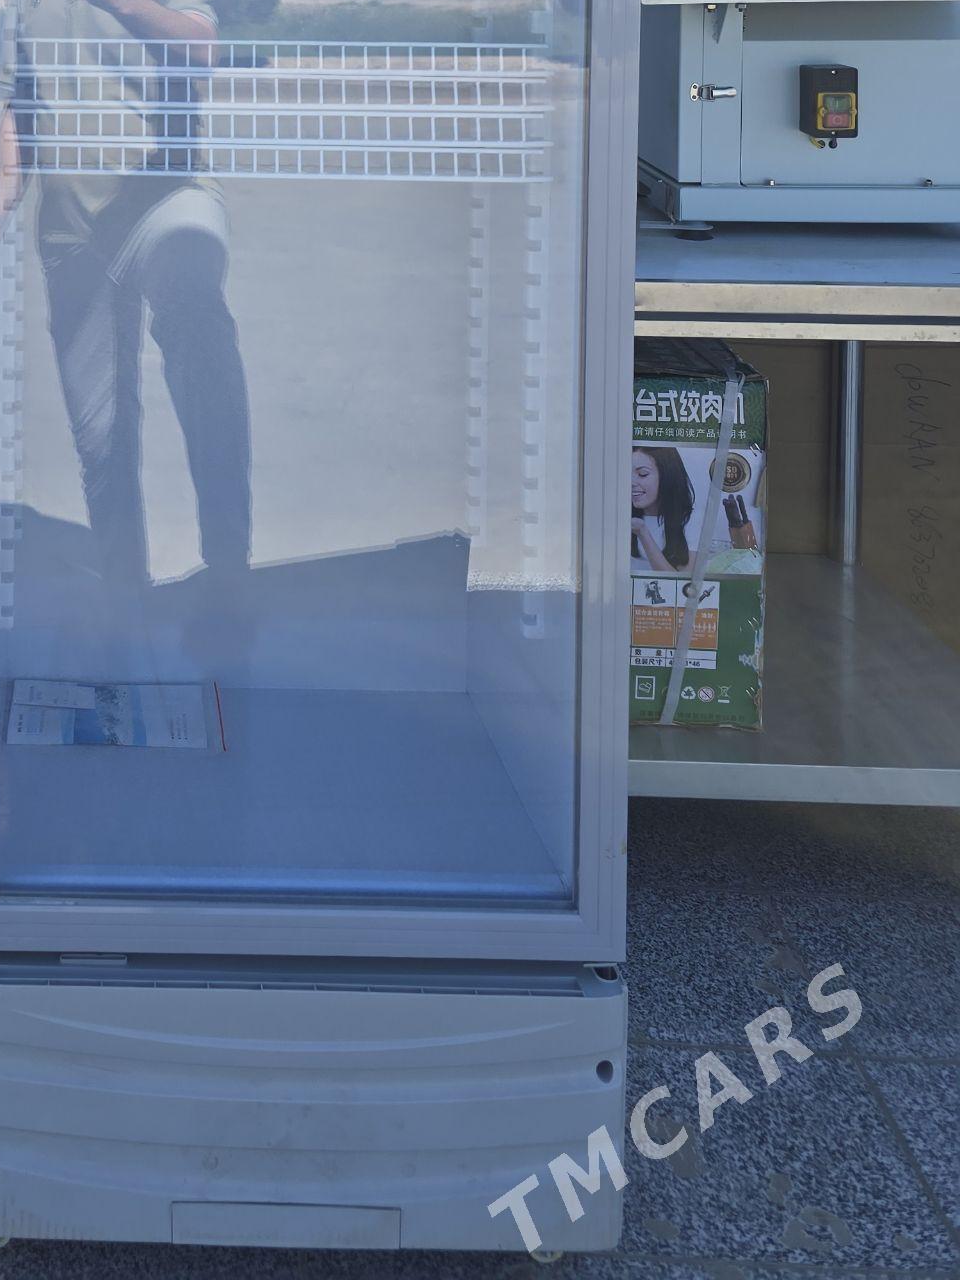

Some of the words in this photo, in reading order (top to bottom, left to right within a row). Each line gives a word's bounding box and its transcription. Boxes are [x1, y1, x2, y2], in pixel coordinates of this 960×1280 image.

[632, 388, 745, 424] 台式绞肉
[633, 426, 747, 440] 前请仔细阅读产品书
